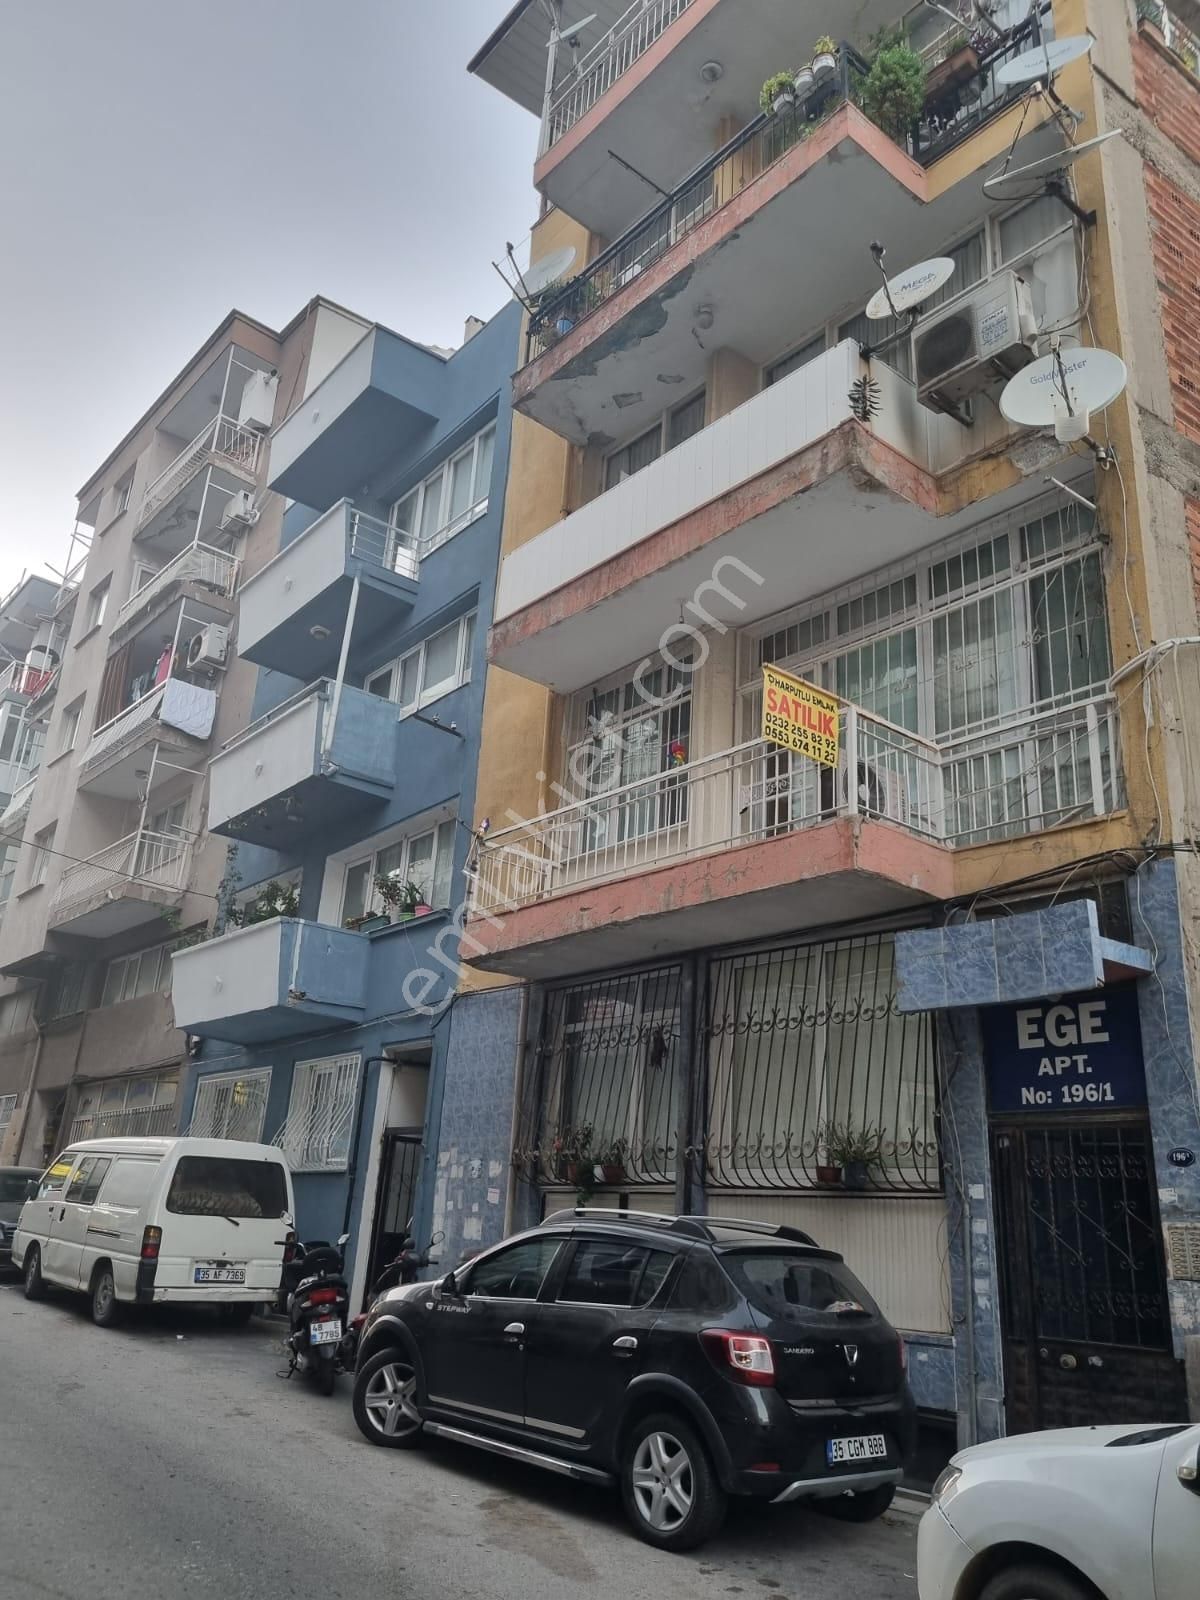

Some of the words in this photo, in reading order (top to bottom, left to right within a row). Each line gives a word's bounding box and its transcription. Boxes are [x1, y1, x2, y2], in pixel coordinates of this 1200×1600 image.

[1030, 359, 1087, 384] GoldMster
[775, 679, 811, 702] HARPUTLU
[812, 695, 836, 713] EMLAK
[767, 687, 835, 739] SATILIK
[764, 725, 790, 744] 0553
[792, 737, 810, 753] 674
[812, 745, 821, 758] 11
[824, 750, 835, 764] 23
[765, 712, 789, 731] 0232
[791, 724, 809, 740] 255
[811, 733, 822, 746] 82
[825, 739, 836, 752] 92
[1016, 1000, 1110, 1049] EGE
[1038, 1054, 1093, 1076] APT.
[1021, 1087, 1053, 1105] No:
[1061, 1082, 1115, 1103] 196/1
[200, 1270, 209, 1279] 35
[213, 1270, 223, 1279] AF
[226, 1270, 245, 1280] 7369
[833, 1440, 844, 1460] 35
[847, 1439, 866, 1458] CGM
[867, 1437, 884, 1455] 888
